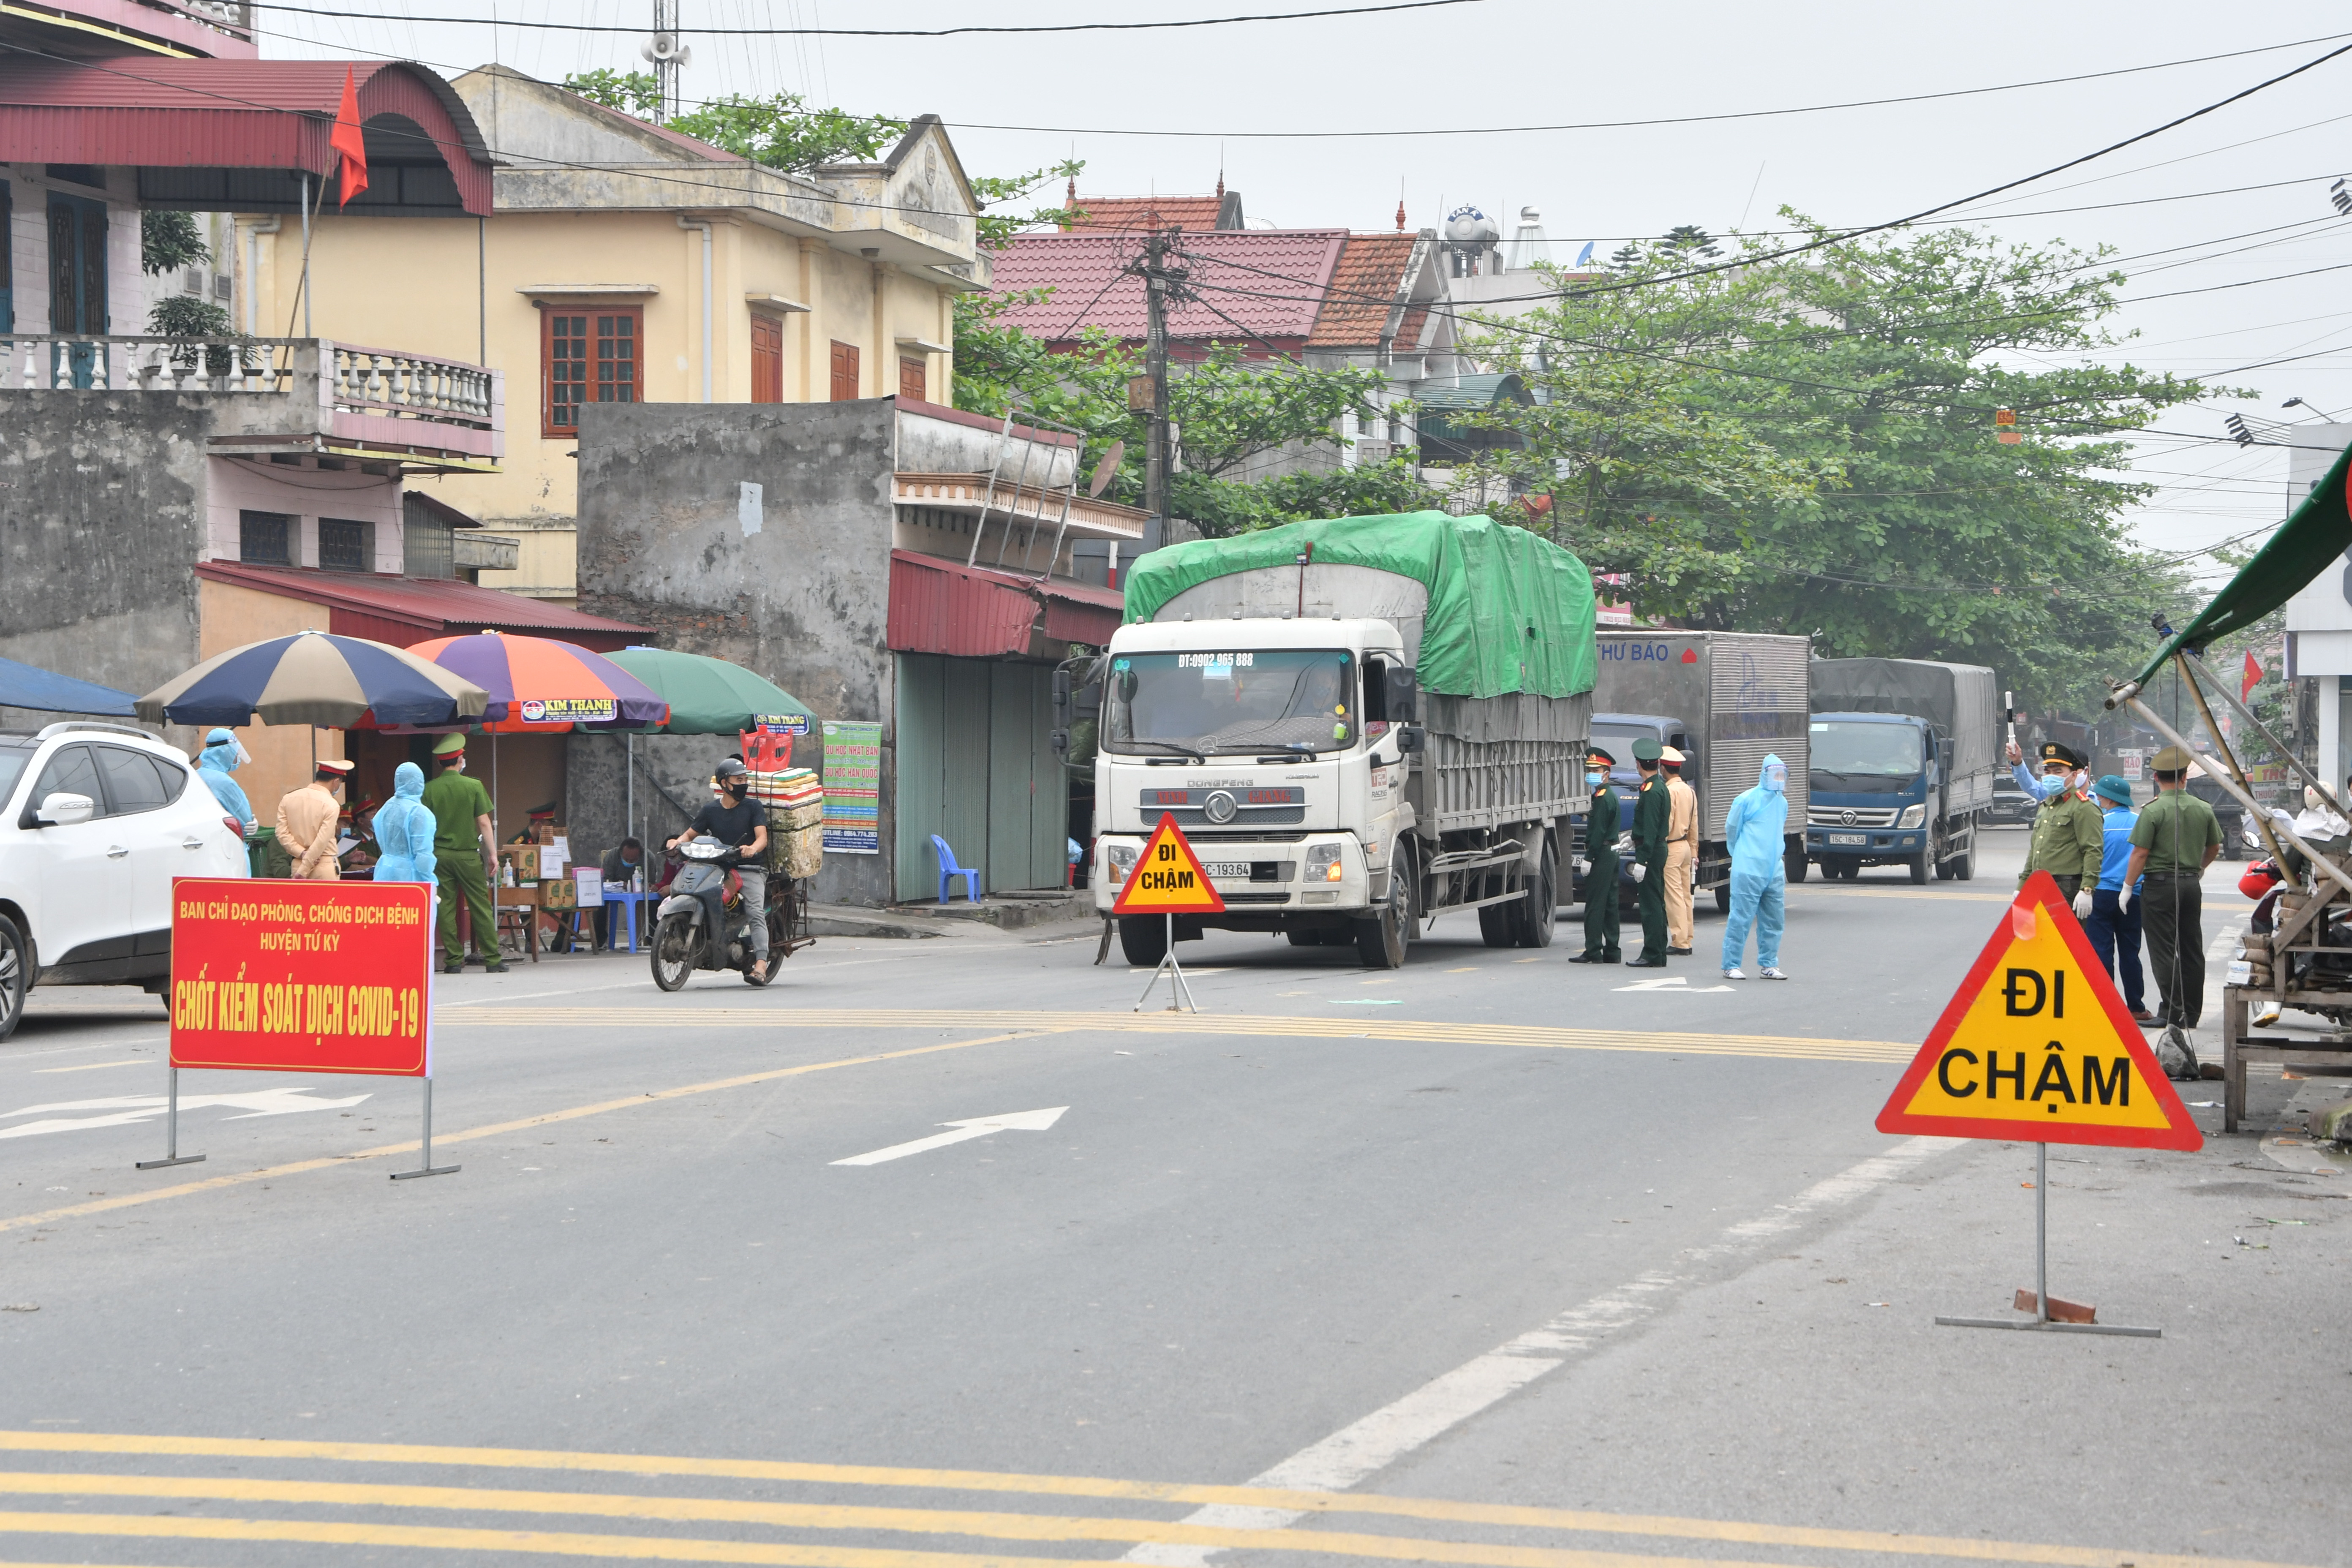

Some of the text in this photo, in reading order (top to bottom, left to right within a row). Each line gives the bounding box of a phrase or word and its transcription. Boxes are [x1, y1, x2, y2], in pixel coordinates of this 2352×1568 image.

[1631, 641, 1668, 661] BÁO
[1179, 653, 1253, 667] ĐT:0902 965 888
[545, 699, 612, 710] KIM THANH
[768, 715, 805, 724] KIM TRANG
[826, 742, 879, 757] DU HỌC NHẬT BẢN
[825, 765, 878, 779] DU HỌC HÀN QUỐC
[1187, 779, 1254, 787] DONGFENG
[1157, 789, 1291, 804] NINH GIANG
[1158, 844, 1176, 861] ĐI
[1141, 868, 1193, 892] CHẬM
[180, 895, 419, 929] BAN CHỈ ĐẠO PHÒNG, CHỐNG DỊCH BỆNH
[260, 928, 340, 956] HUYỆN TỨ KỲ
[2001, 968, 2064, 1018] ĐI
[175, 961, 419, 1045] CHỐT KIỂM SOÁT DỊCH COVID-19
[1938, 1040, 2130, 1113] CHẬM
